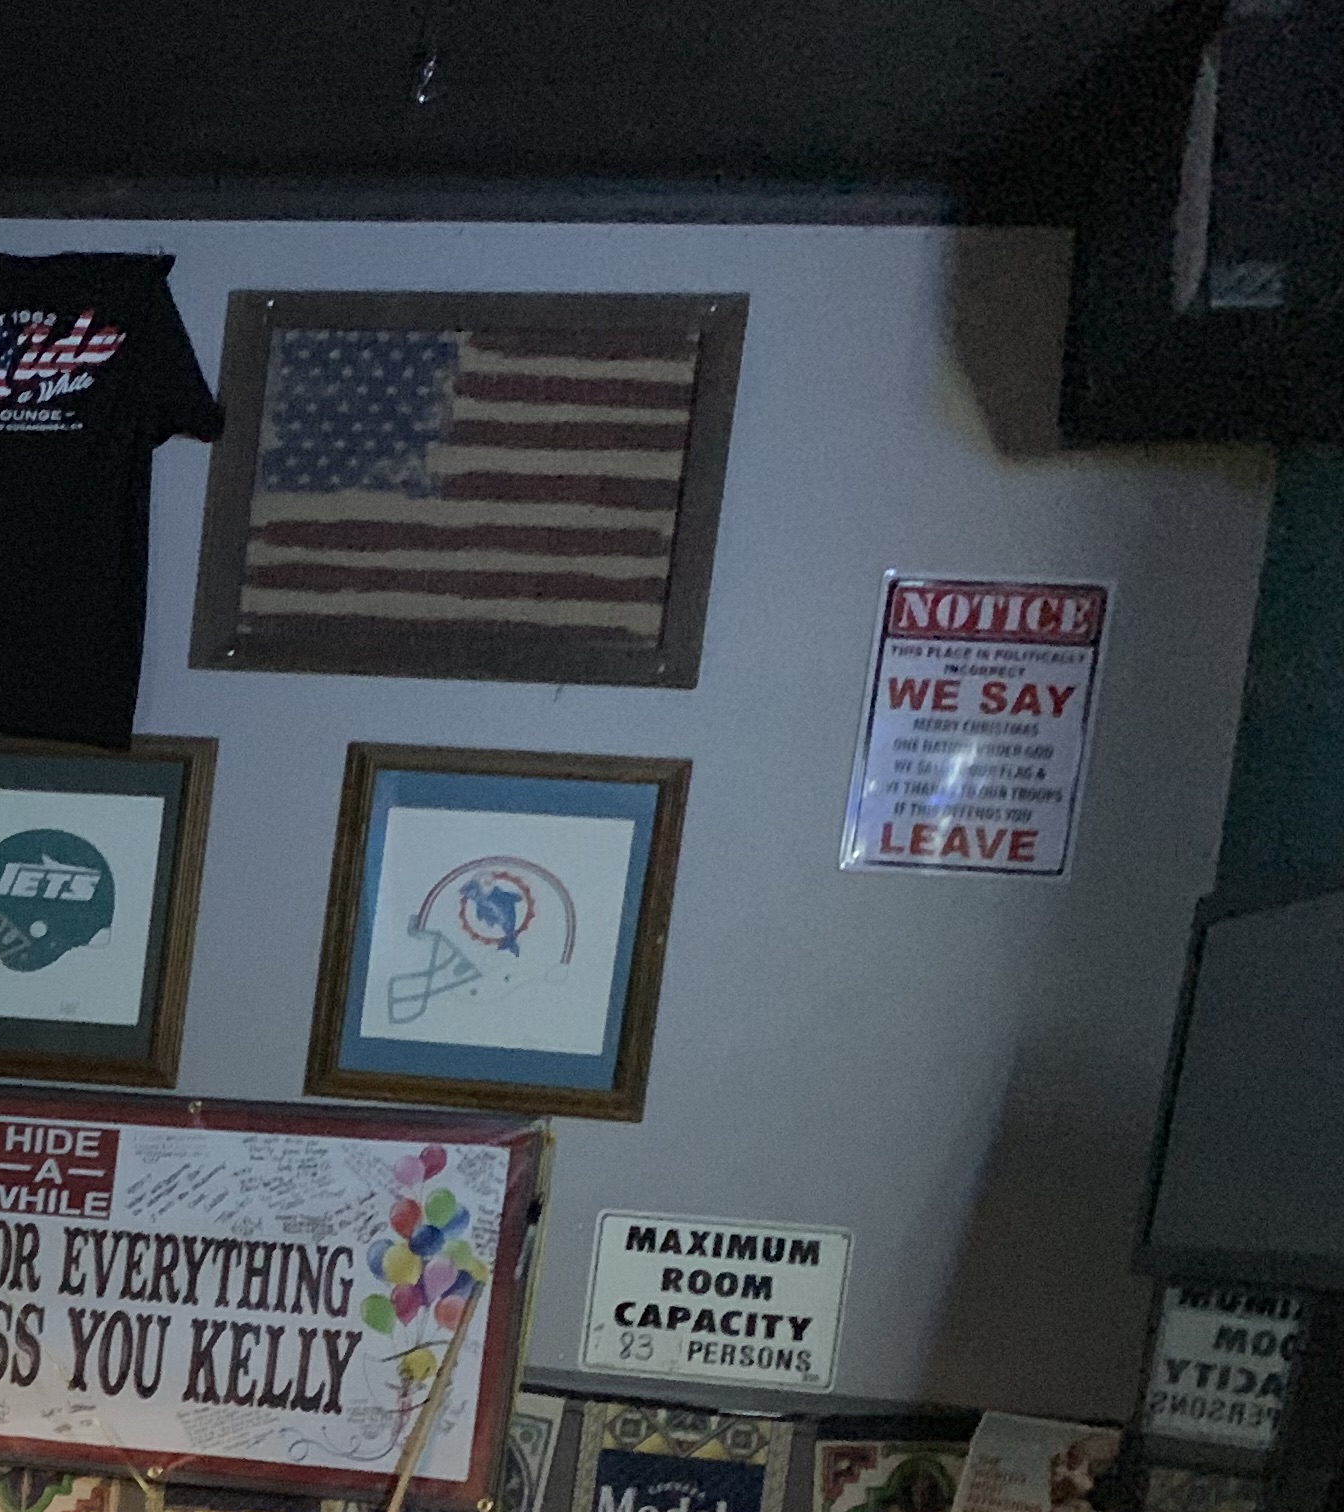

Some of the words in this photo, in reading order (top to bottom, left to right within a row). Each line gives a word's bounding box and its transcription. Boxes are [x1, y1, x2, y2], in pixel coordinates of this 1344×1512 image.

[13, 309, 58, 327] 1962
[37, 371, 96, 404] While
[898, 593, 1093, 634] NOTICE
[927, 646, 970, 660] PLACE
[995, 649, 1086, 664] POLITICALLY
[943, 664, 1026, 678] INCORRECT
[887, 676, 961, 713] WE
[979, 681, 1077, 719] SAY
[913, 717, 960, 734] MERRY
[963, 720, 1039, 736] CHRISTMAS
[892, 736, 919, 751] ONE
[998, 765, 1034, 781] FLAG
[1012, 786, 1063, 803] TROOPS
[879, 821, 1040, 863] LEAVE
[5, 1125, 102, 1157] HIDE
[33, 1162, 63, 1184] A
[625, 1225, 822, 1267] MAXIMUM
[57, 1225, 355, 1318] EVERYTHING
[661, 1267, 773, 1302] ROOM
[614, 1301, 814, 1342] CAPACITY
[67, 1307, 172, 1401] YOU
[181, 1317, 363, 1416] KELLY
[687, 1340, 813, 1374] PERSONS
